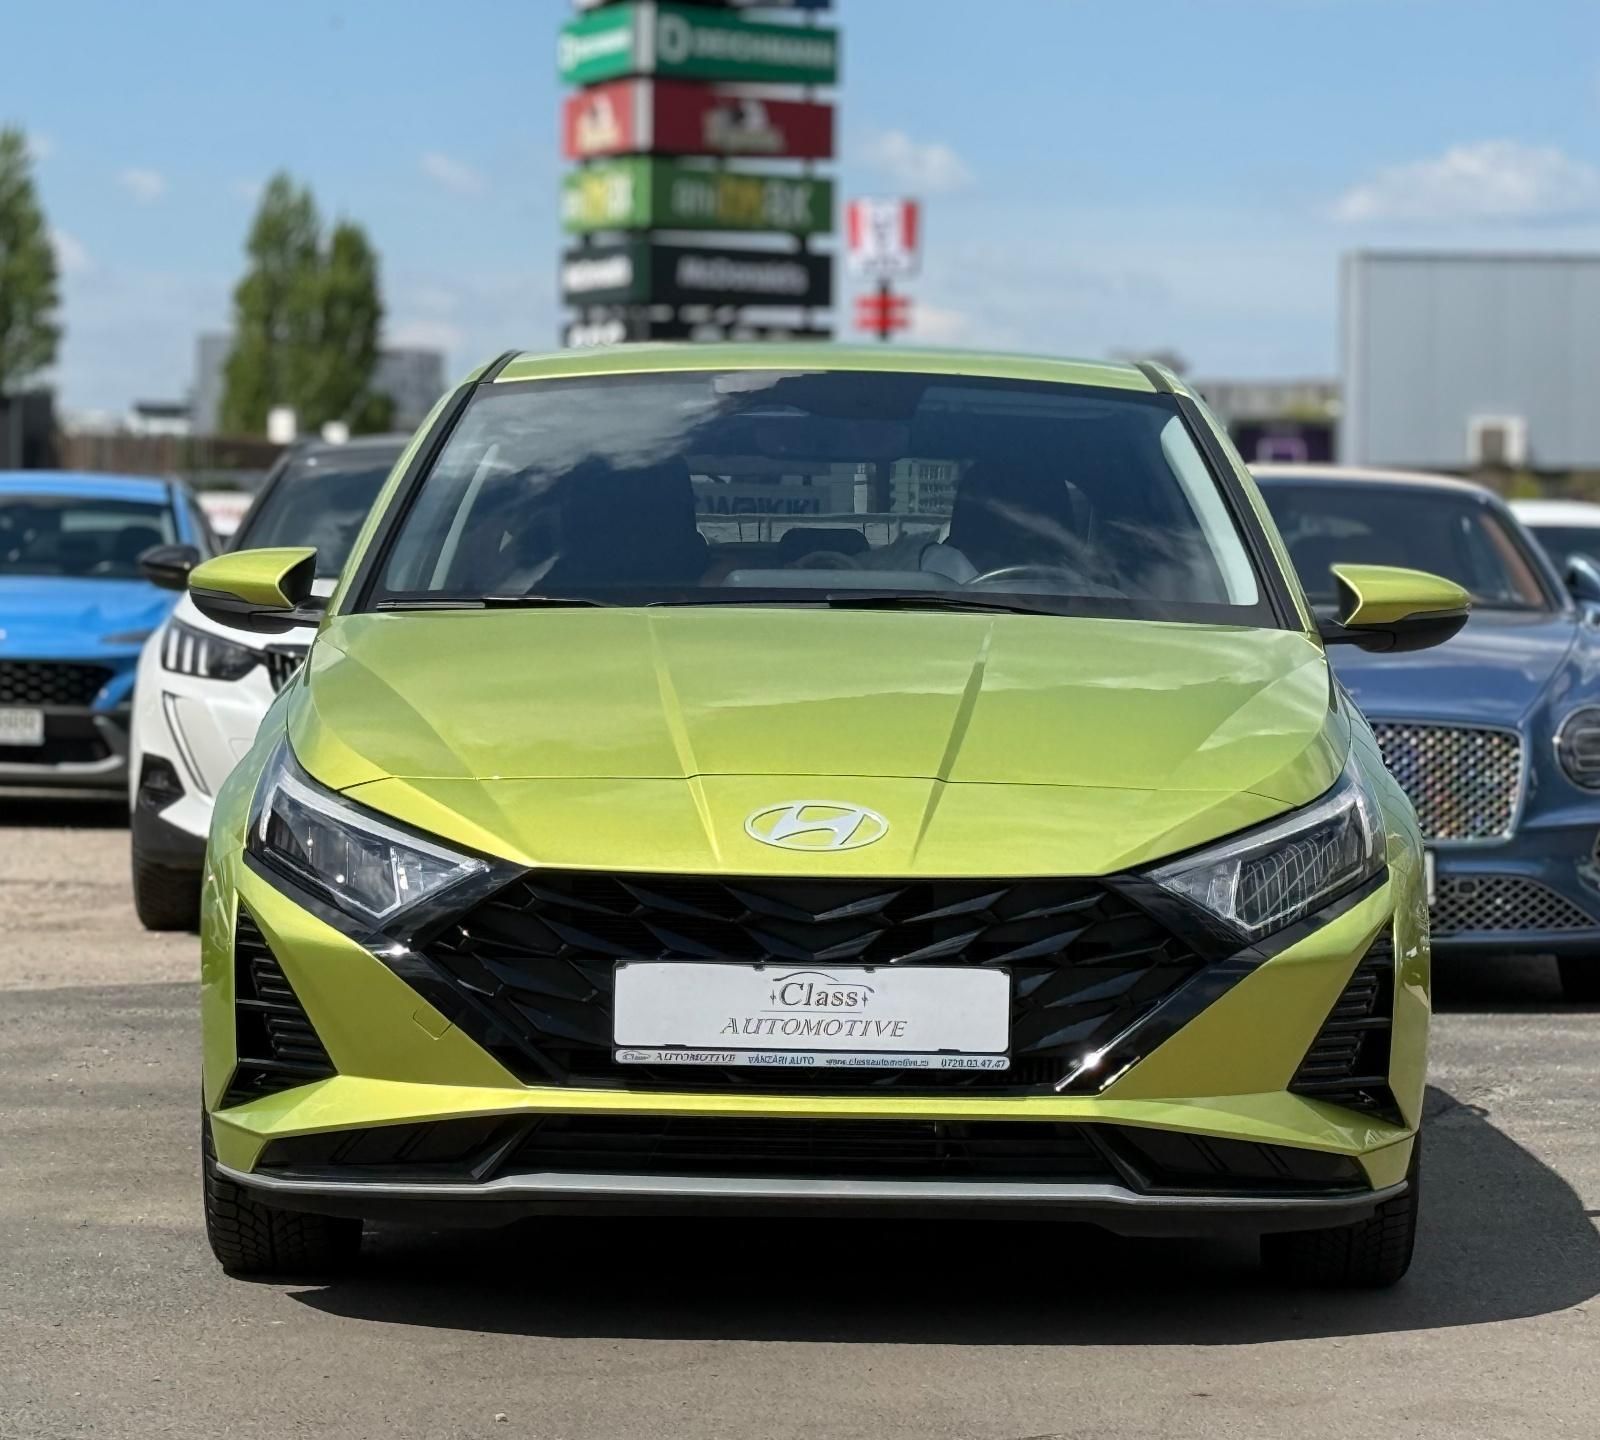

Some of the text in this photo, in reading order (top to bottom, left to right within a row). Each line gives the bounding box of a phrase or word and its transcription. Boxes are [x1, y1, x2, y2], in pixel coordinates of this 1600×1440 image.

[778, 981, 859, 1007] Class
[720, 1017, 908, 1037] AUTOMOTIVE
[655, 1053, 736, 1062] AUTOMOTIVE
[789, 1055, 815, 1065] AUTO
